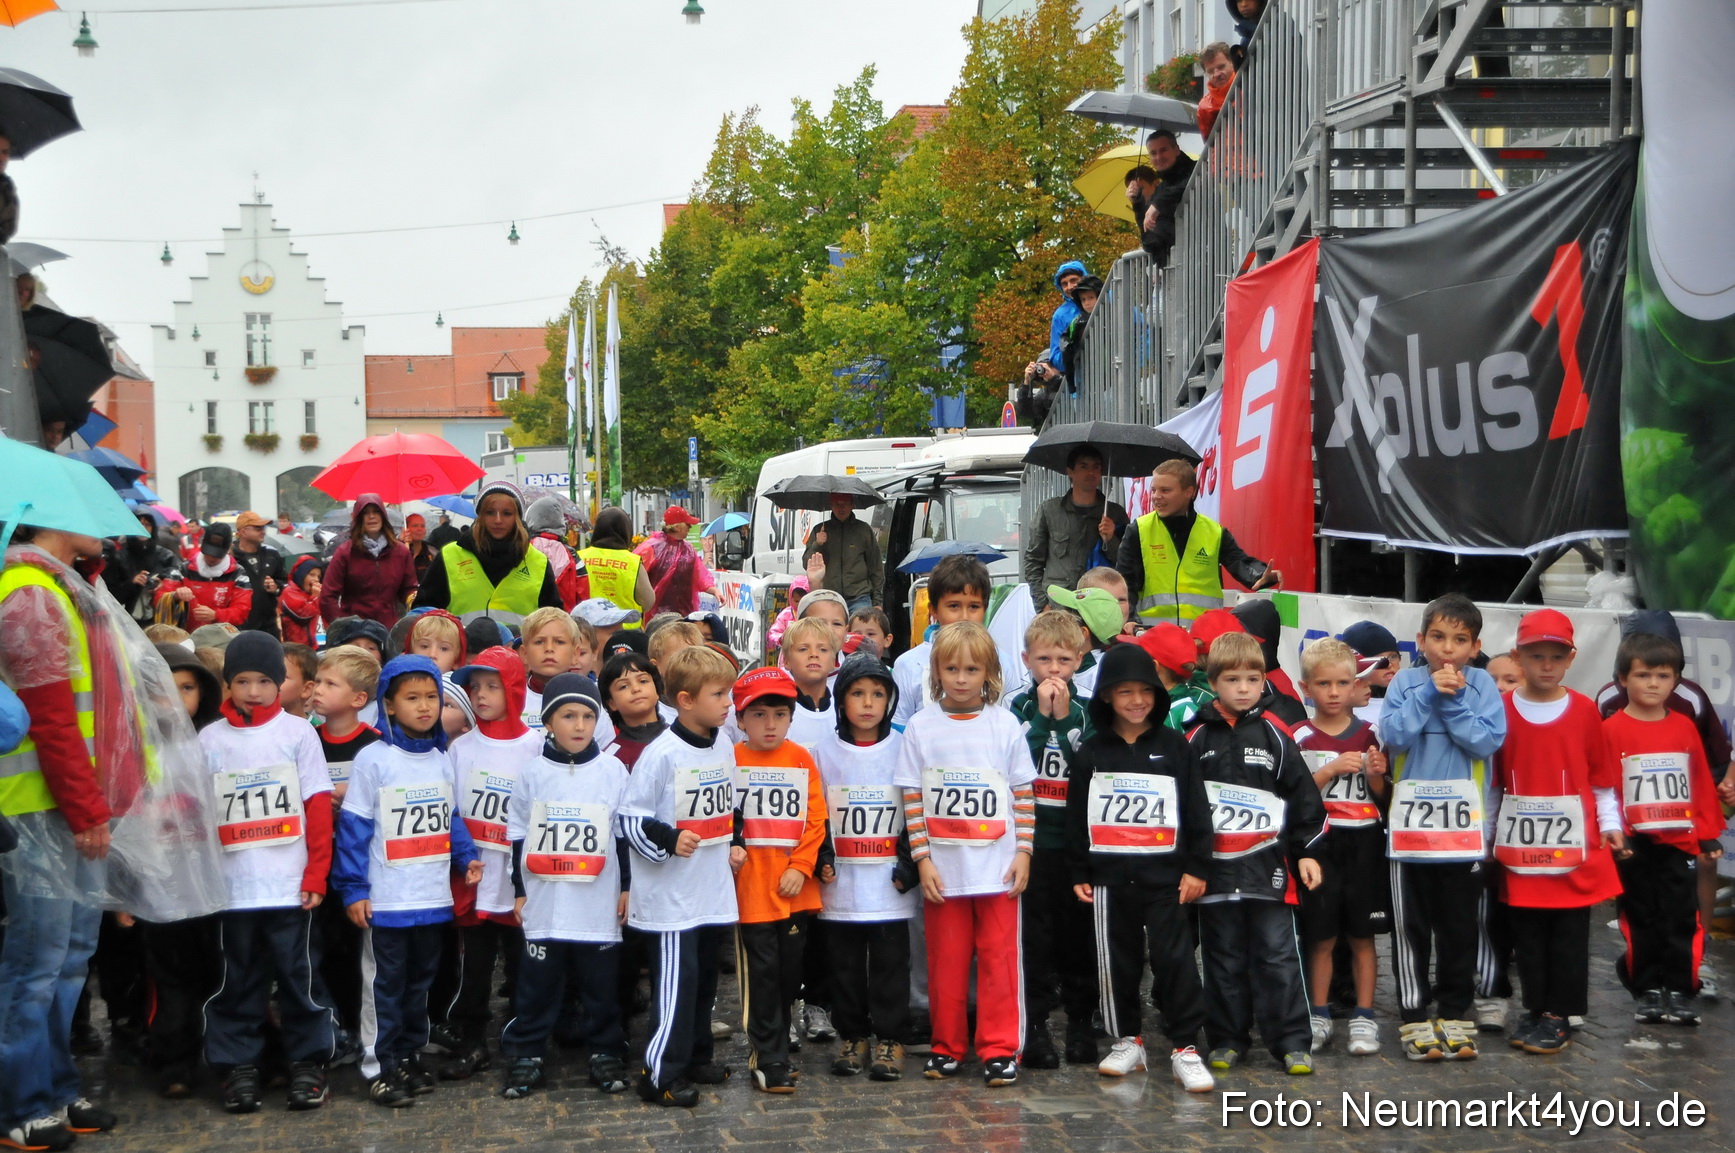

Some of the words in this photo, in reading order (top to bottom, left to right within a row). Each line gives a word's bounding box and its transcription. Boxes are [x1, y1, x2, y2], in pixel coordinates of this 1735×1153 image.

[584, 558, 628, 570] HELFER
[743, 671, 781, 685] Ferrari
[1641, 757, 1675, 768] BOCK
[236, 771, 270, 784] BOCK
[699, 768, 725, 781] BOCK
[750, 771, 785, 782] BOCK
[943, 772, 980, 782] BOCK
[486, 776, 515, 788] BOC
[1113, 779, 1149, 789] BOCK
[1326, 774, 1368, 802] 219
[1629, 773, 1689, 803] 7108
[406, 788, 438, 800] BOCK
[849, 790, 884, 800] BOCK
[1034, 783, 1066, 798] stian
[1220, 788, 1257, 803] BOCK
[1414, 786, 1453, 796] BOCK
[223, 785, 291, 821] 7114
[471, 789, 511, 824] 709
[686, 782, 733, 818] 7309
[737, 787, 800, 818] 7198
[931, 787, 997, 818] 7250
[1517, 801, 1554, 811] BOCK
[547, 806, 582, 818] BOCK
[1099, 795, 1166, 825] 7224
[1400, 800, 1471, 829] 7216
[392, 803, 449, 836] 7258
[837, 806, 897, 835] 7077
[231, 821, 285, 841] Leonard
[1505, 816, 1573, 845] 7072
[538, 823, 598, 854] 7128
[854, 842, 883, 854] Thilo
[552, 858, 575, 871] Tim
[1523, 851, 1552, 864] Luca
